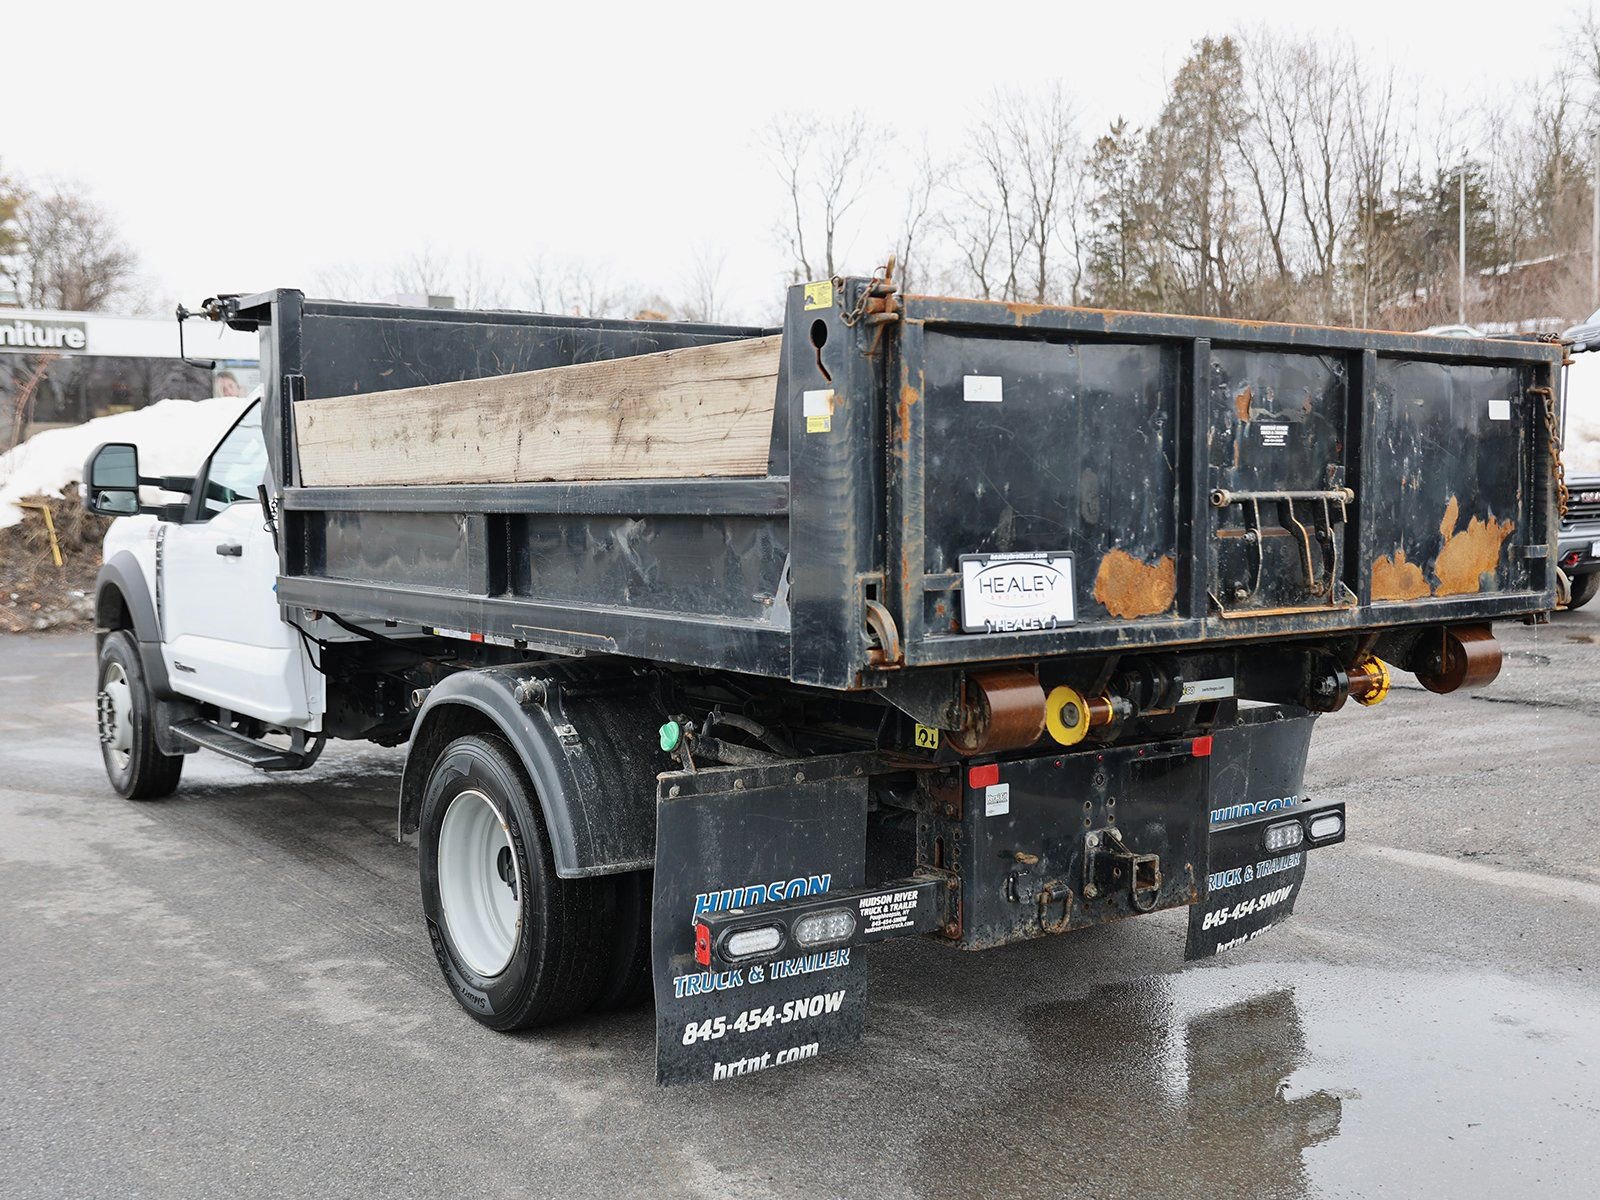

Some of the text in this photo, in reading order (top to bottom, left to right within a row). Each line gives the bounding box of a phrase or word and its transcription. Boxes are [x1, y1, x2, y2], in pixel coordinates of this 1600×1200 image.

[979, 575, 1058, 594] HEALEY
[995, 617, 1047, 632] HEALEY
[1208, 852, 1301, 892] RUCK & TRAILER
[859, 890, 918, 908] HUDSON RIVER
[860, 900, 917, 917] TRUCK & TRAILER
[1202, 884, 1294, 930] 845-454-SNOW
[673, 948, 850, 998] TRUCK & TRAILER
[682, 990, 846, 1046] 845-454-SNOW
[711, 1042, 819, 1081] hrtnt.com
